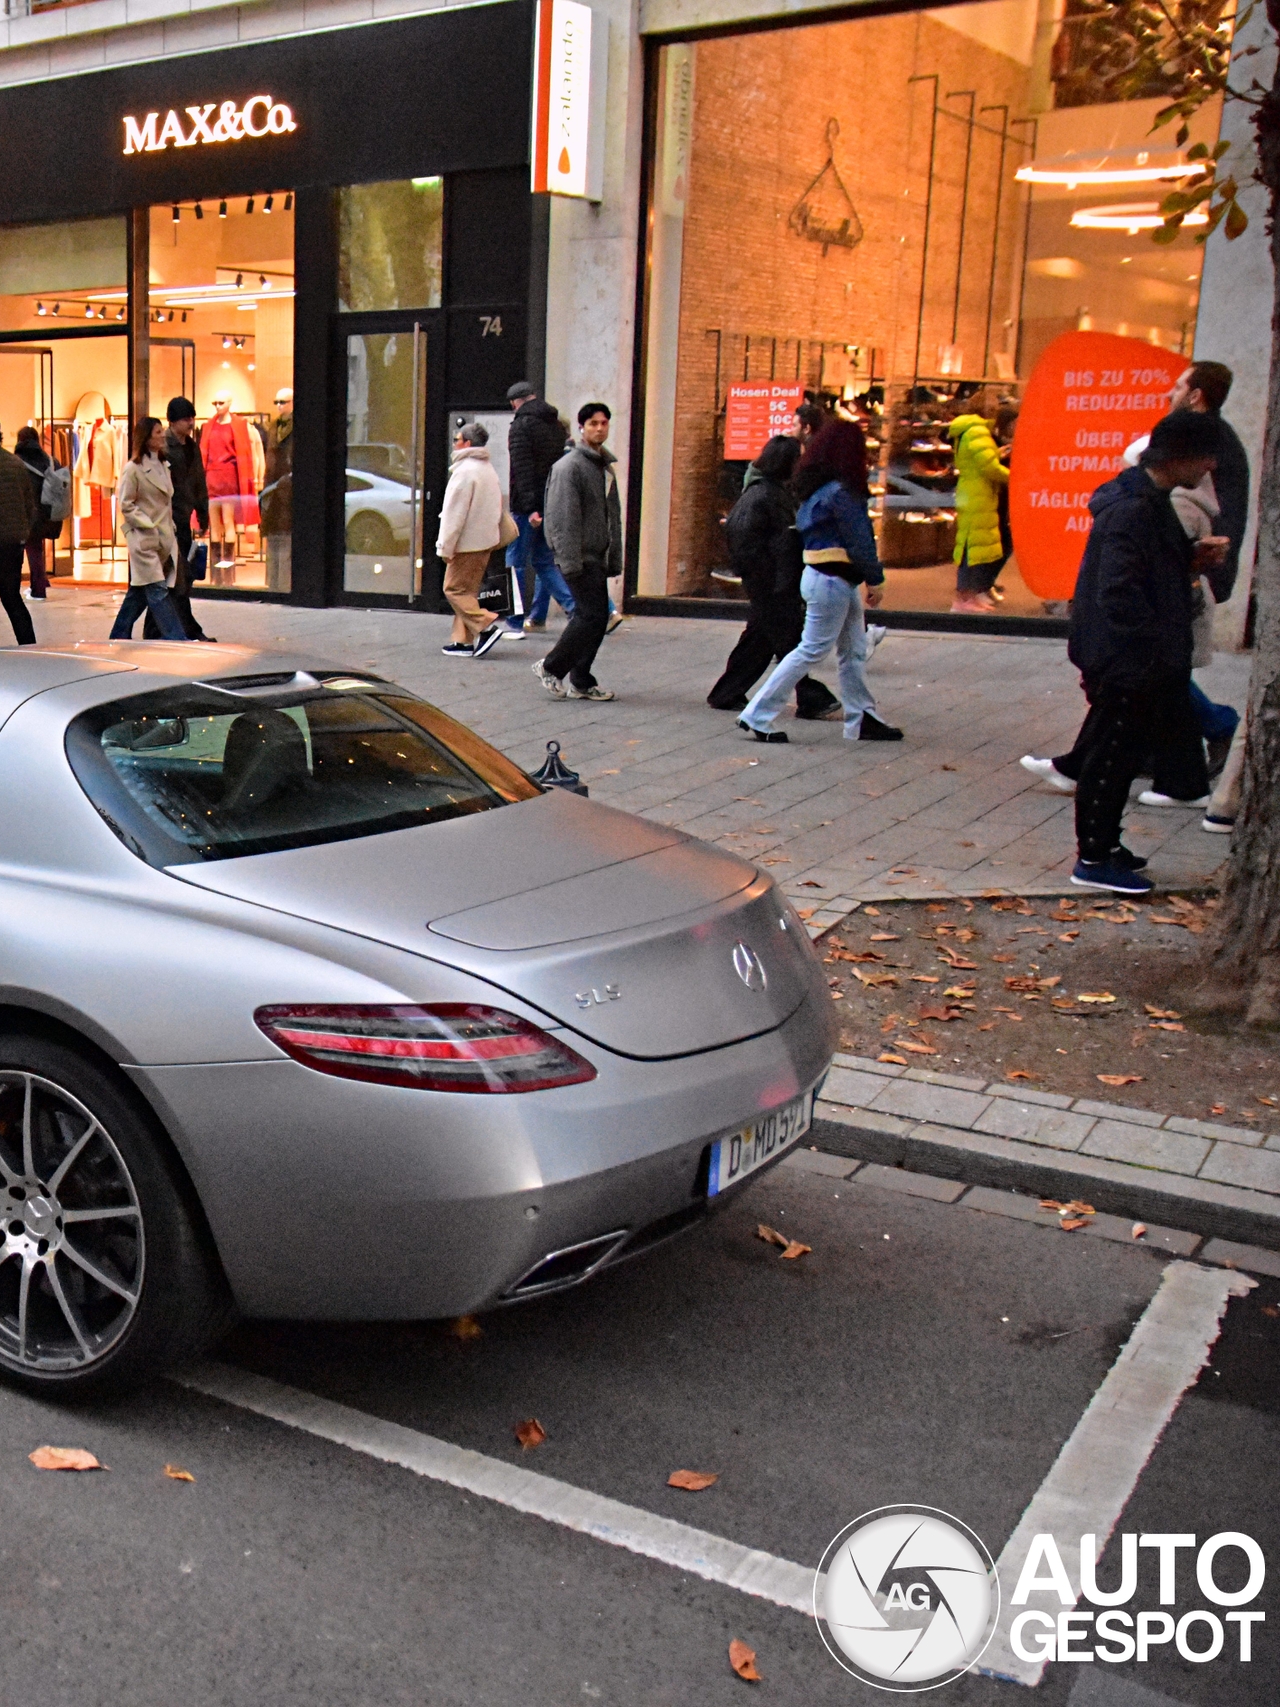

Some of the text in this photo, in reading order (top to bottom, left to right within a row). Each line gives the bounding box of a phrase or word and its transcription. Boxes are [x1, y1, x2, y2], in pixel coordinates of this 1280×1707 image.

[559, 19, 574, 138] zalando
[122, 94, 297, 155] MAX&Co.
[479, 316, 503, 337] 74
[1064, 368, 1171, 388] BIS ZU 70%
[731, 386, 799, 397] Hosen Deal
[769, 401, 787, 412] 5€
[1066, 393, 1168, 411] REDUZIERT
[769, 415, 792, 425] 10€
[1075, 429, 1124, 448] ÜBER
[1048, 455, 1124, 472] TOPMAR
[1029, 489, 1091, 509] TÄGLIC
[1065, 516, 1094, 532] AU
[575, 984, 621, 1009] SLS
[728, 1133, 742, 1178] D
[753, 1116, 777, 1163] MD
